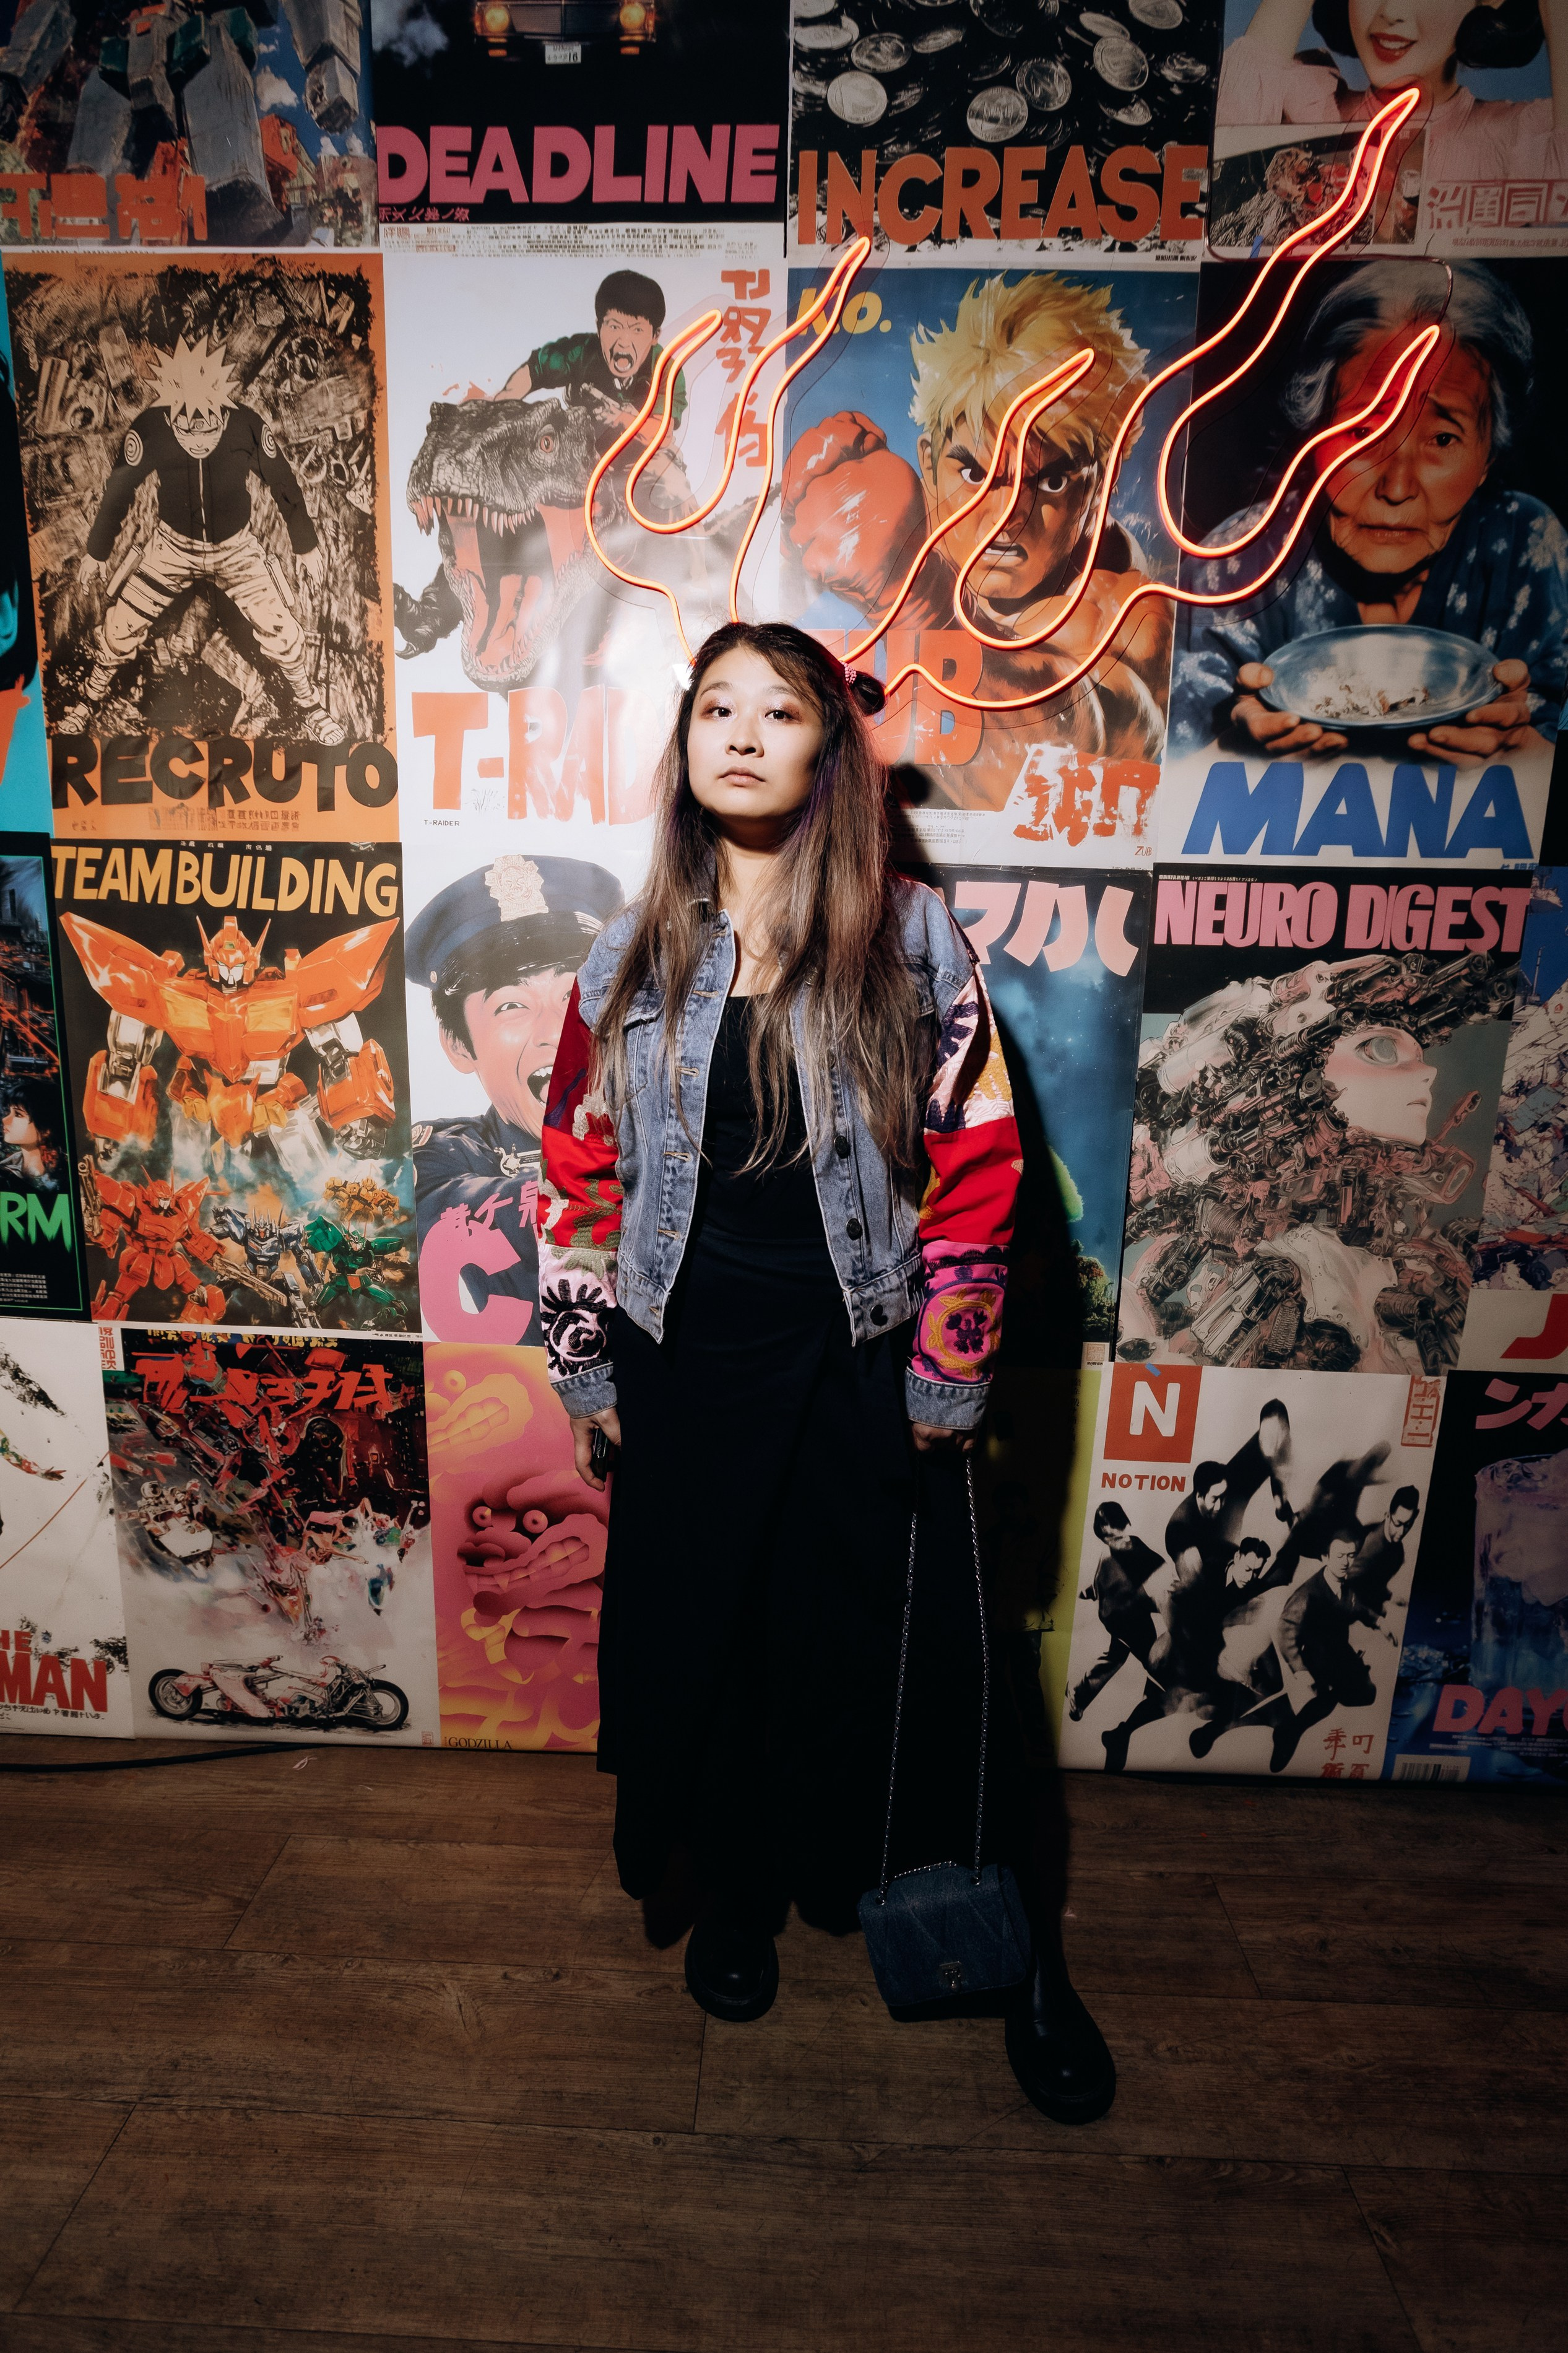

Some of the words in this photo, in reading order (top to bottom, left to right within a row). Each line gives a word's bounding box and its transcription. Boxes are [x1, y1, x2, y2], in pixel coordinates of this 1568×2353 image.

[378, 124, 780, 204] DEADLINE
[798, 145, 1208, 245] INCREASE
[51, 735, 398, 811] RECRUTO
[1181, 762, 1533, 859] MANA
[1154, 880, 1338, 949] NEURO
[1345, 884, 1531, 953] DIGEST
[1130, 1381, 1180, 1437] N
[1101, 1472, 1186, 1492] NOTION
[448, 1736, 513, 1750] GODZILLA
